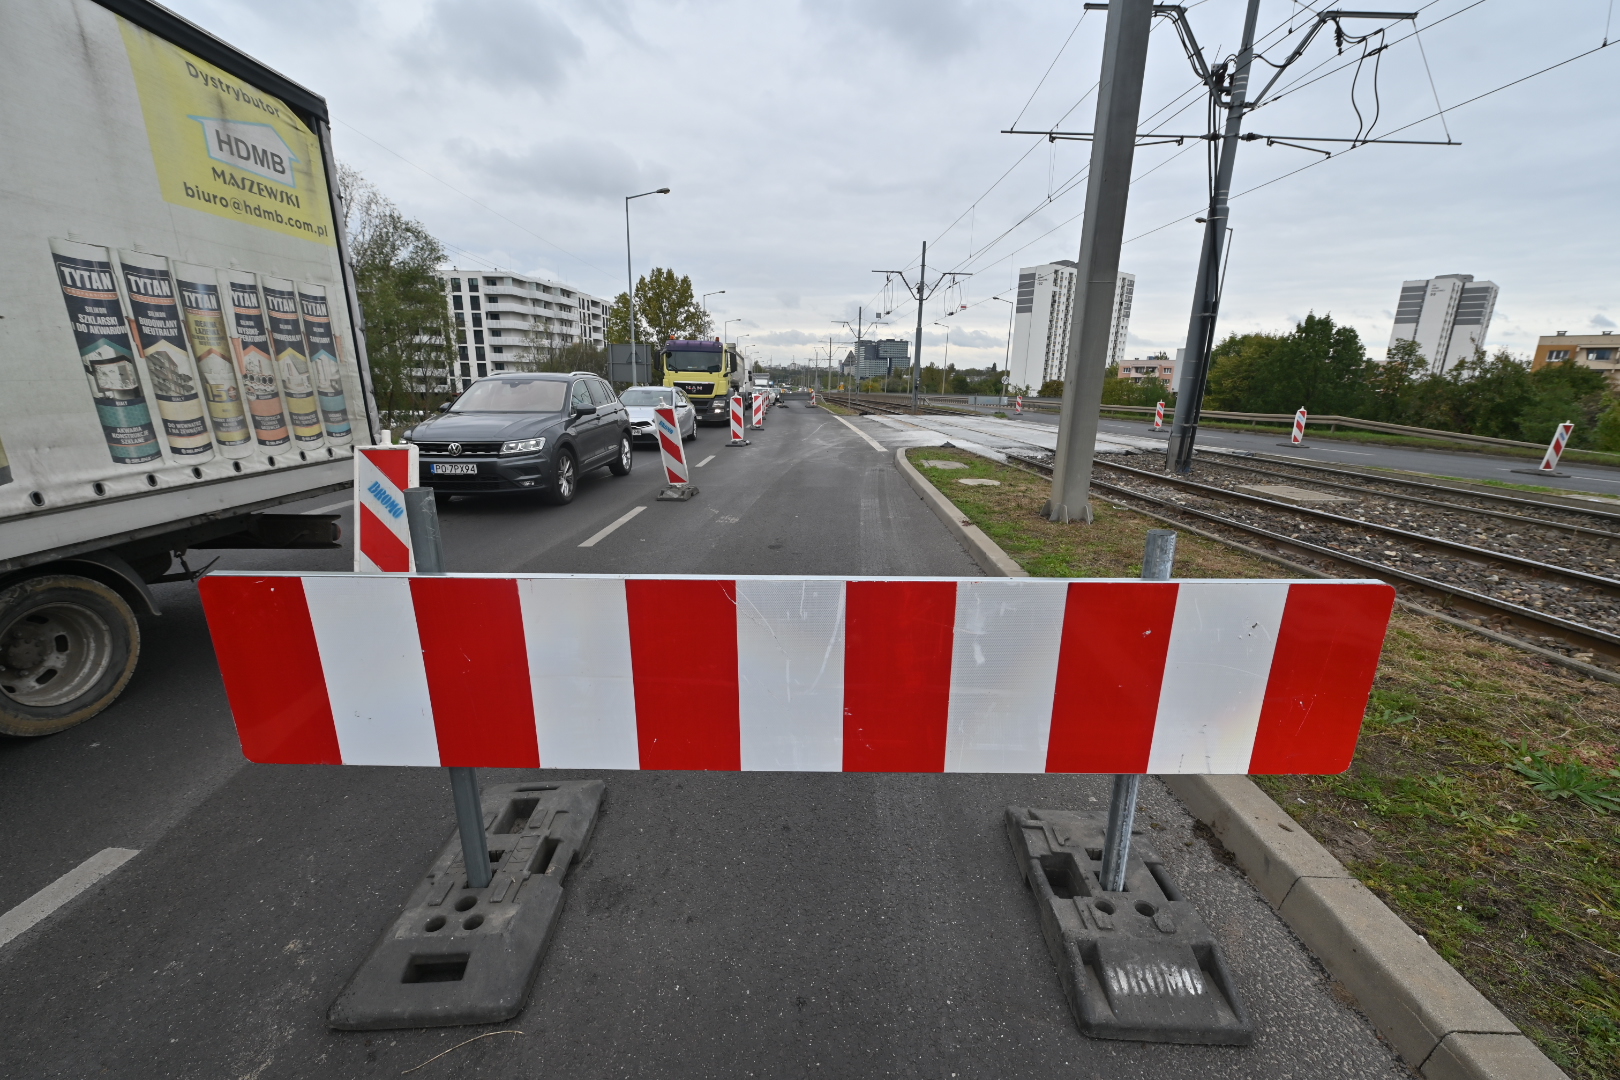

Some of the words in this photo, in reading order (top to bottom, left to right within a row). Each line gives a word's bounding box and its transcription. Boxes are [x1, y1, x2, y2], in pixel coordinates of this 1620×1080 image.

[185, 60, 281, 118] Dystrybutor
[214, 128, 286, 175] HDMB
[211, 166, 300, 209] MASZEWSKI
[183, 181, 328, 238] biuro@hdmb.com.pl
[61, 266, 113, 290] TYTAN
[127, 274, 171, 296] TYTAN
[182, 291, 218, 310] TYTAN
[231, 291, 258, 307] YTAN
[266, 295, 295, 312] TYTAN
[84, 305, 107, 314] SILIKON
[301, 300, 328, 316] TYTAN
[76, 322, 88, 333] DO
[78, 314, 118, 326] SZKLARSKI
[138, 317, 178, 328] BUDOWLANY
[142, 325, 178, 337] NEUTRALNY
[111, 430, 149, 440] KONSTRUKCJE
[117, 426, 142, 434] AKWARIA
[121, 437, 145, 445] SZKLANE
[435, 464, 447, 473] PO
[448, 464, 476, 473] 7PX94
[367, 480, 404, 519] BROMO
